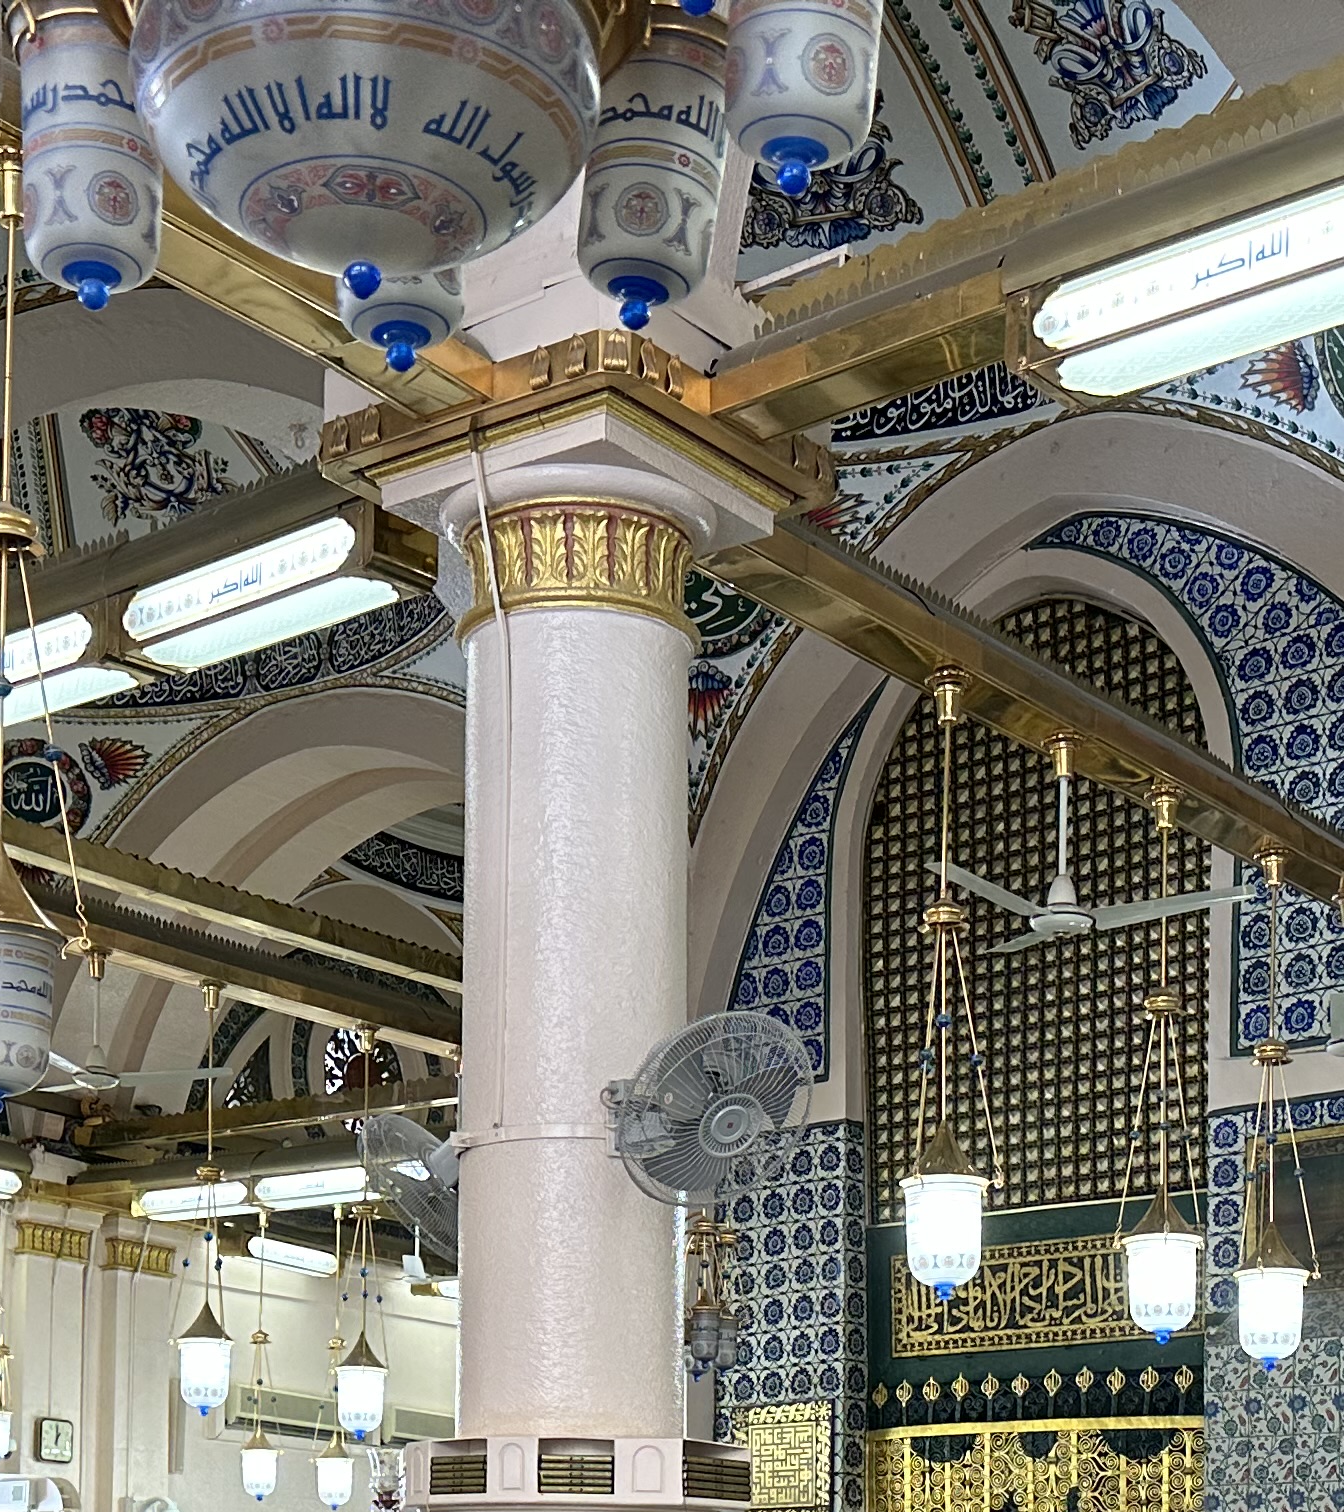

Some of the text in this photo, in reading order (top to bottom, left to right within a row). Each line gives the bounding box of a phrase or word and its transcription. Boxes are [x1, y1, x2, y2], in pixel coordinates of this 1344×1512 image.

[221, 84, 270, 146] الله
[422, 99, 492, 150] الله
[1189, 226, 1289, 290] الله اكبر
[244, 562, 262, 586] الله
